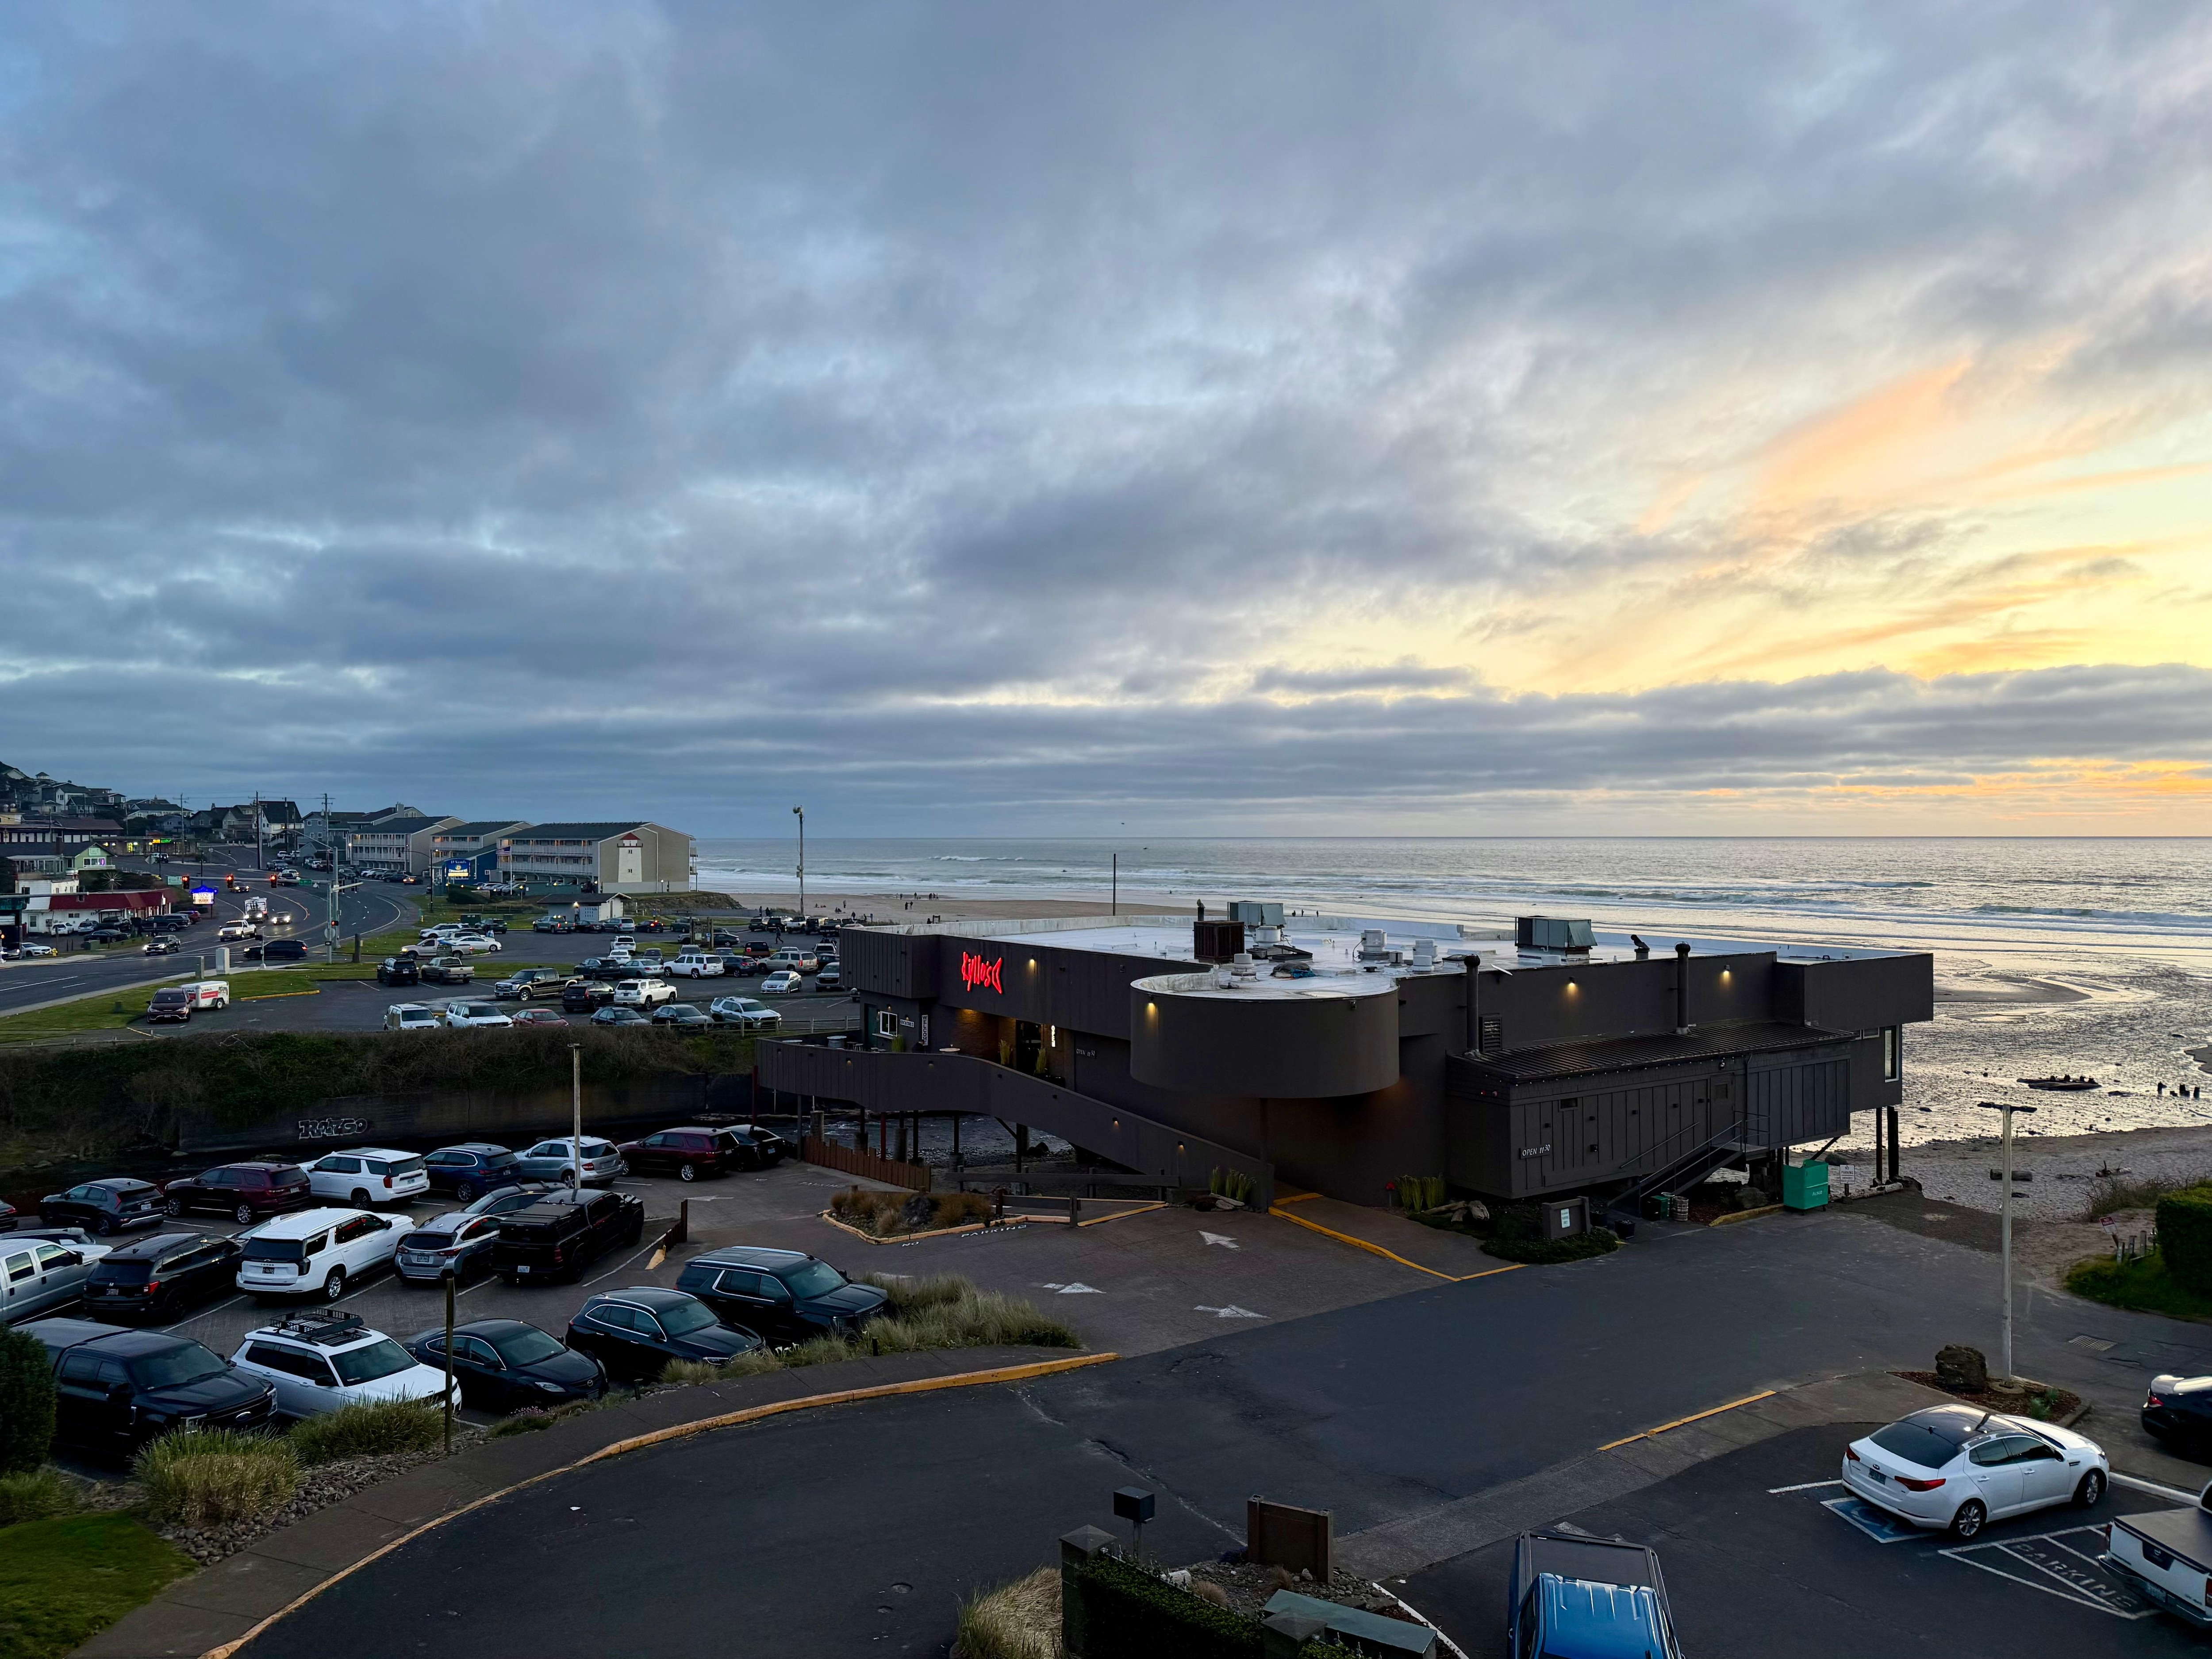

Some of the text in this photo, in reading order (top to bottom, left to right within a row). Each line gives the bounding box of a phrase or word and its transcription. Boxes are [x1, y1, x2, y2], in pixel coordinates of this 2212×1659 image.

[1522, 1148, 1537, 1156] OPEN
[961, 1224, 1026, 1238] PARKING
[2016, 1544, 2138, 1607] PARKING
